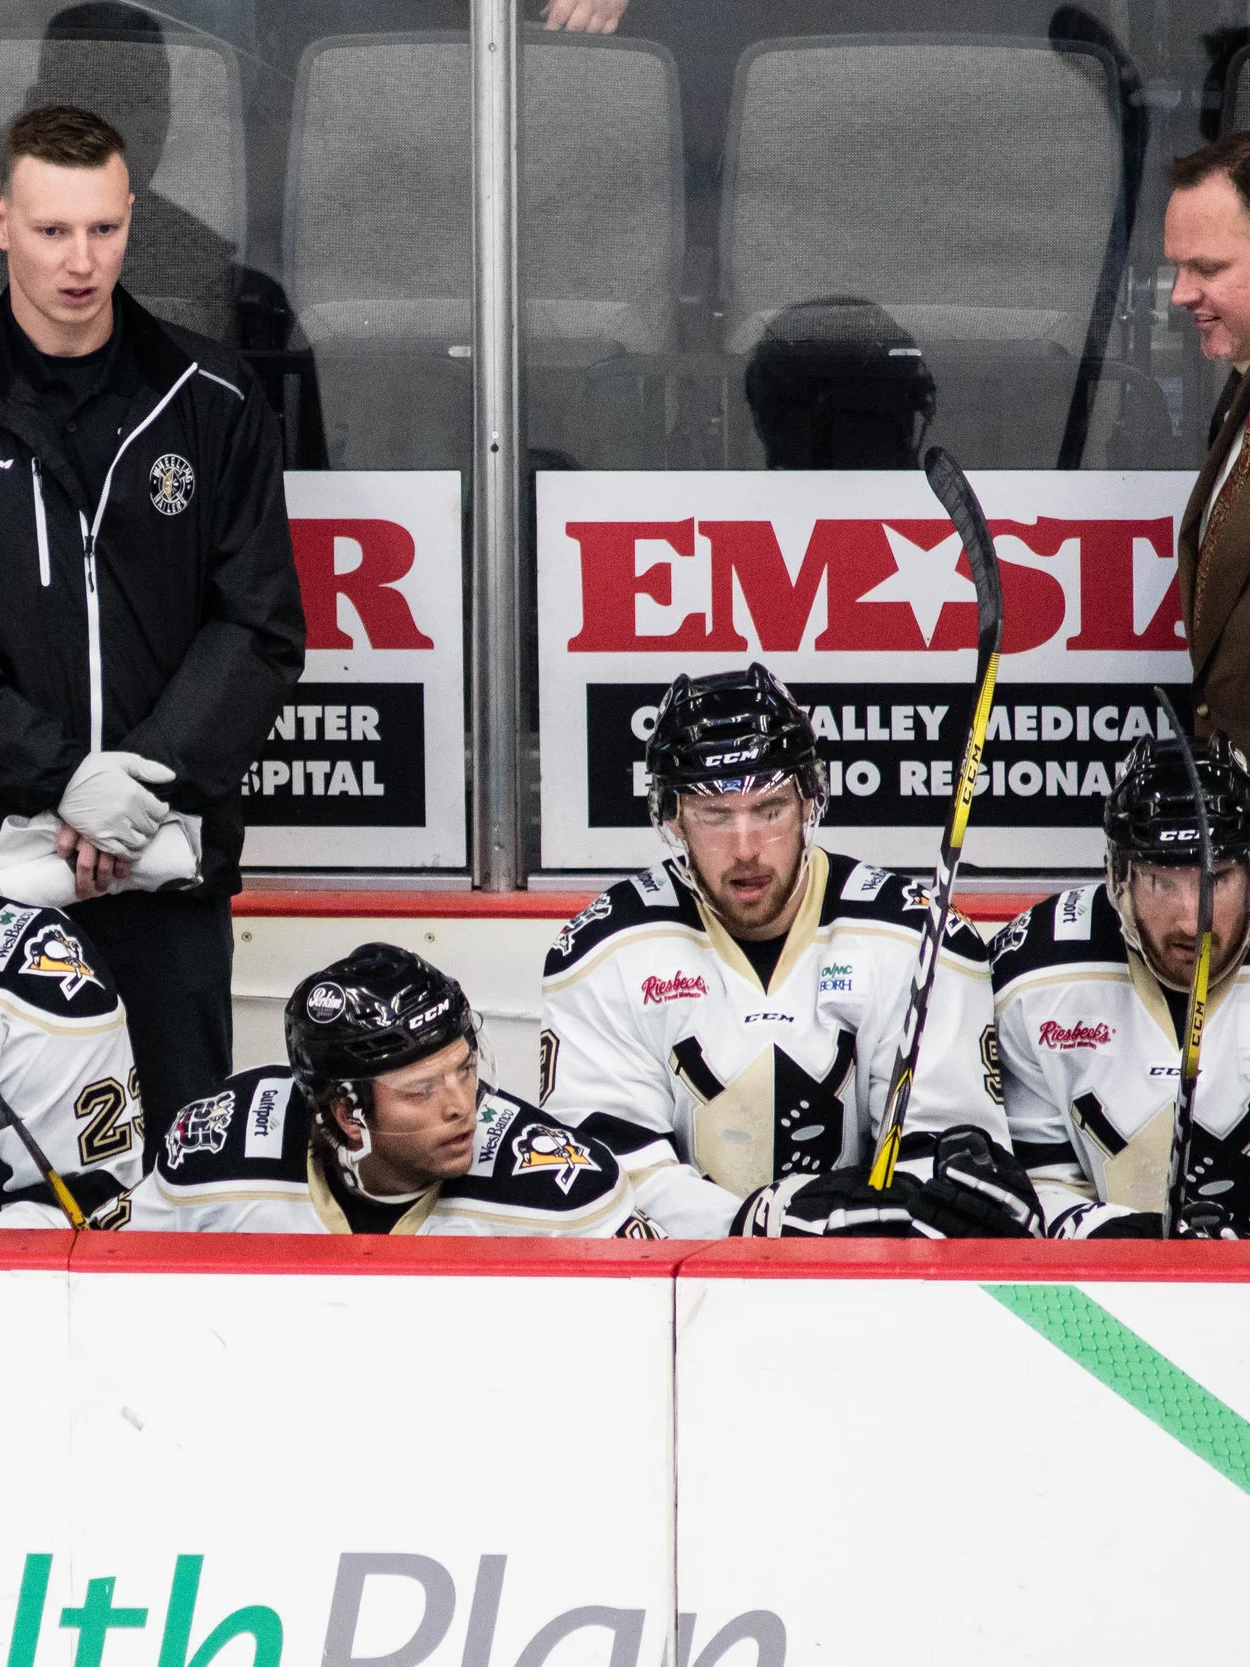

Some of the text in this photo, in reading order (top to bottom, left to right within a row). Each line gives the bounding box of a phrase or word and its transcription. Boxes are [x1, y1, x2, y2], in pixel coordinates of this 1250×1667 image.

[152, 456, 193, 484] WHEELING
[565, 516, 1189, 655] EMST
[267, 705, 382, 741] NTER
[799, 705, 949, 741] ALLEY
[705, 748, 760, 768] CCM
[962, 743, 982, 805] CCM
[241, 760, 385, 796] SPITAL
[408, 998, 450, 1031] CCM
[744, 1013, 795, 1023] CCM
[1191, 1001, 1205, 1048] CCM
[1038, 1020, 1112, 1050] Riesbeck's
[1150, 1067, 1203, 1076] CC
[252, 1089, 279, 1137] Gulfport
[478, 1108, 514, 1164] WesBanco
